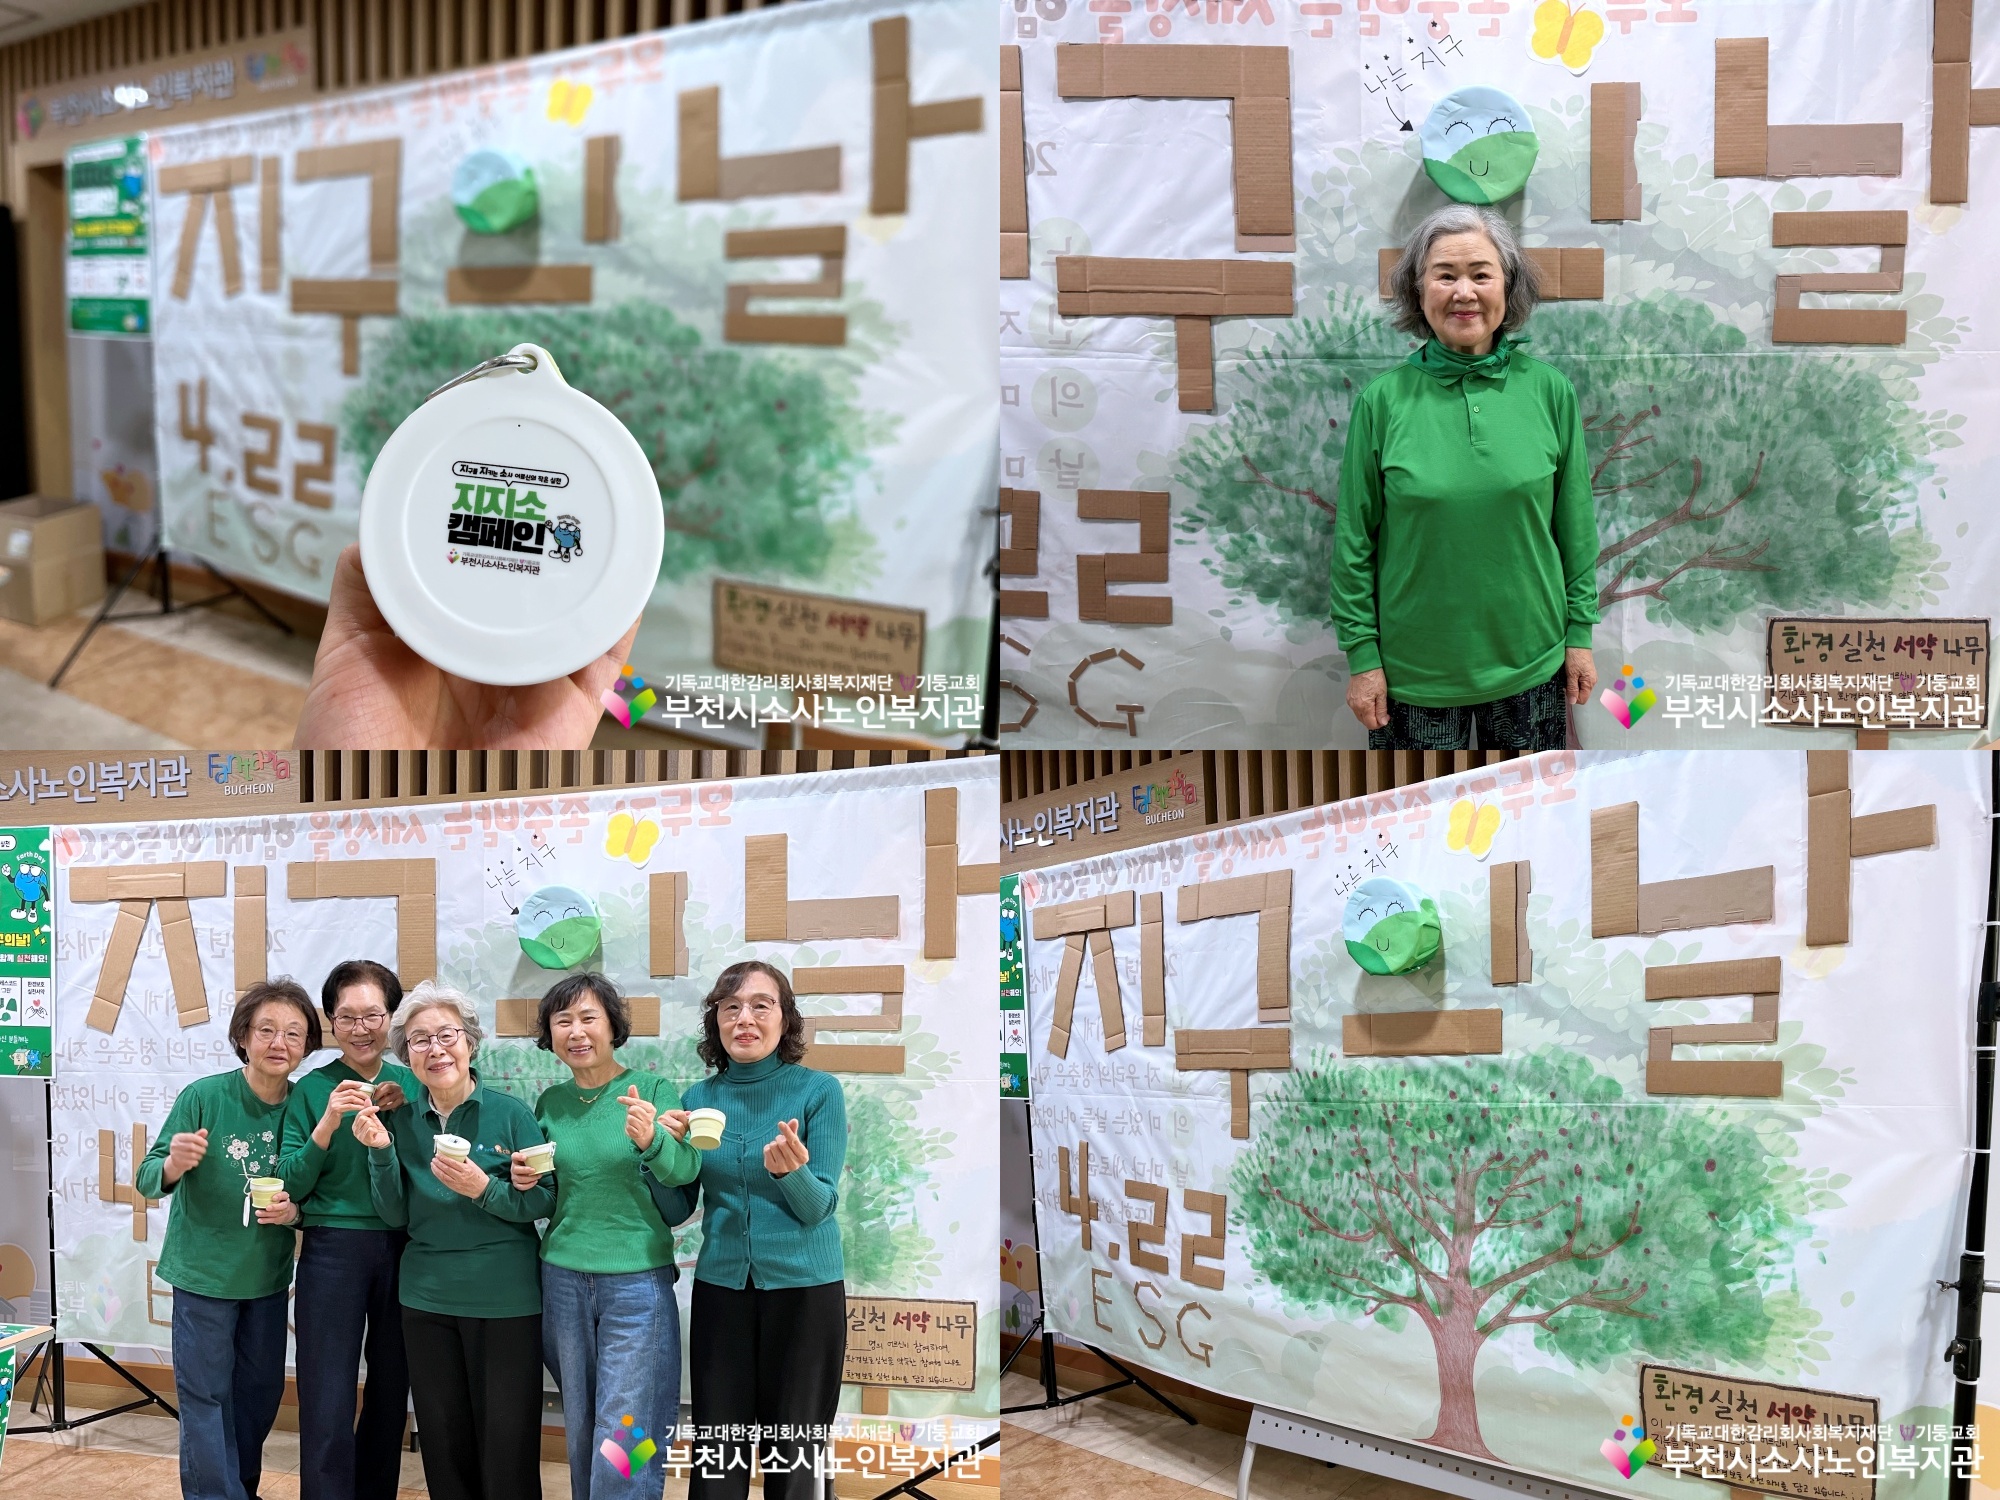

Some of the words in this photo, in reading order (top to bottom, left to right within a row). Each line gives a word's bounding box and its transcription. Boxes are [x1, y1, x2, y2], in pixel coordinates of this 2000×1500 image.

[1363, 65, 1413, 94] 나는
[1411, 35, 1465, 70] 지구
[452, 483, 547, 522] 지지소
[448, 513, 546, 555] 캠페인
[460, 556, 541, 576] 부천시소사노인복지관
[1781, 625, 1834, 664] 환경
[1838, 629, 1886, 663] 실천
[1893, 632, 1939, 662] 서약
[1943, 636, 1985, 666] 나무
[224, 783, 275, 796] BUCHEON
[1145, 808, 1186, 826] BUCHEON
[16, 851, 34, 862] Earth
[34, 852, 46, 864] Day
[486, 868, 520, 889] 나는
[519, 843, 557, 871] 지구
[1364, 841, 1399, 873] 지구
[1058, 1140, 1227, 1290] 4.22
[847, 1306, 886, 1332] 실천
[893, 1311, 931, 1334] 서약
[936, 1315, 972, 1339] 나무
[1092, 1268, 1213, 1367] ESG
[1652, 1373, 1703, 1414] 환경
[1709, 1389, 1758, 1423] 실천
[1766, 1401, 1816, 1431] 서약
